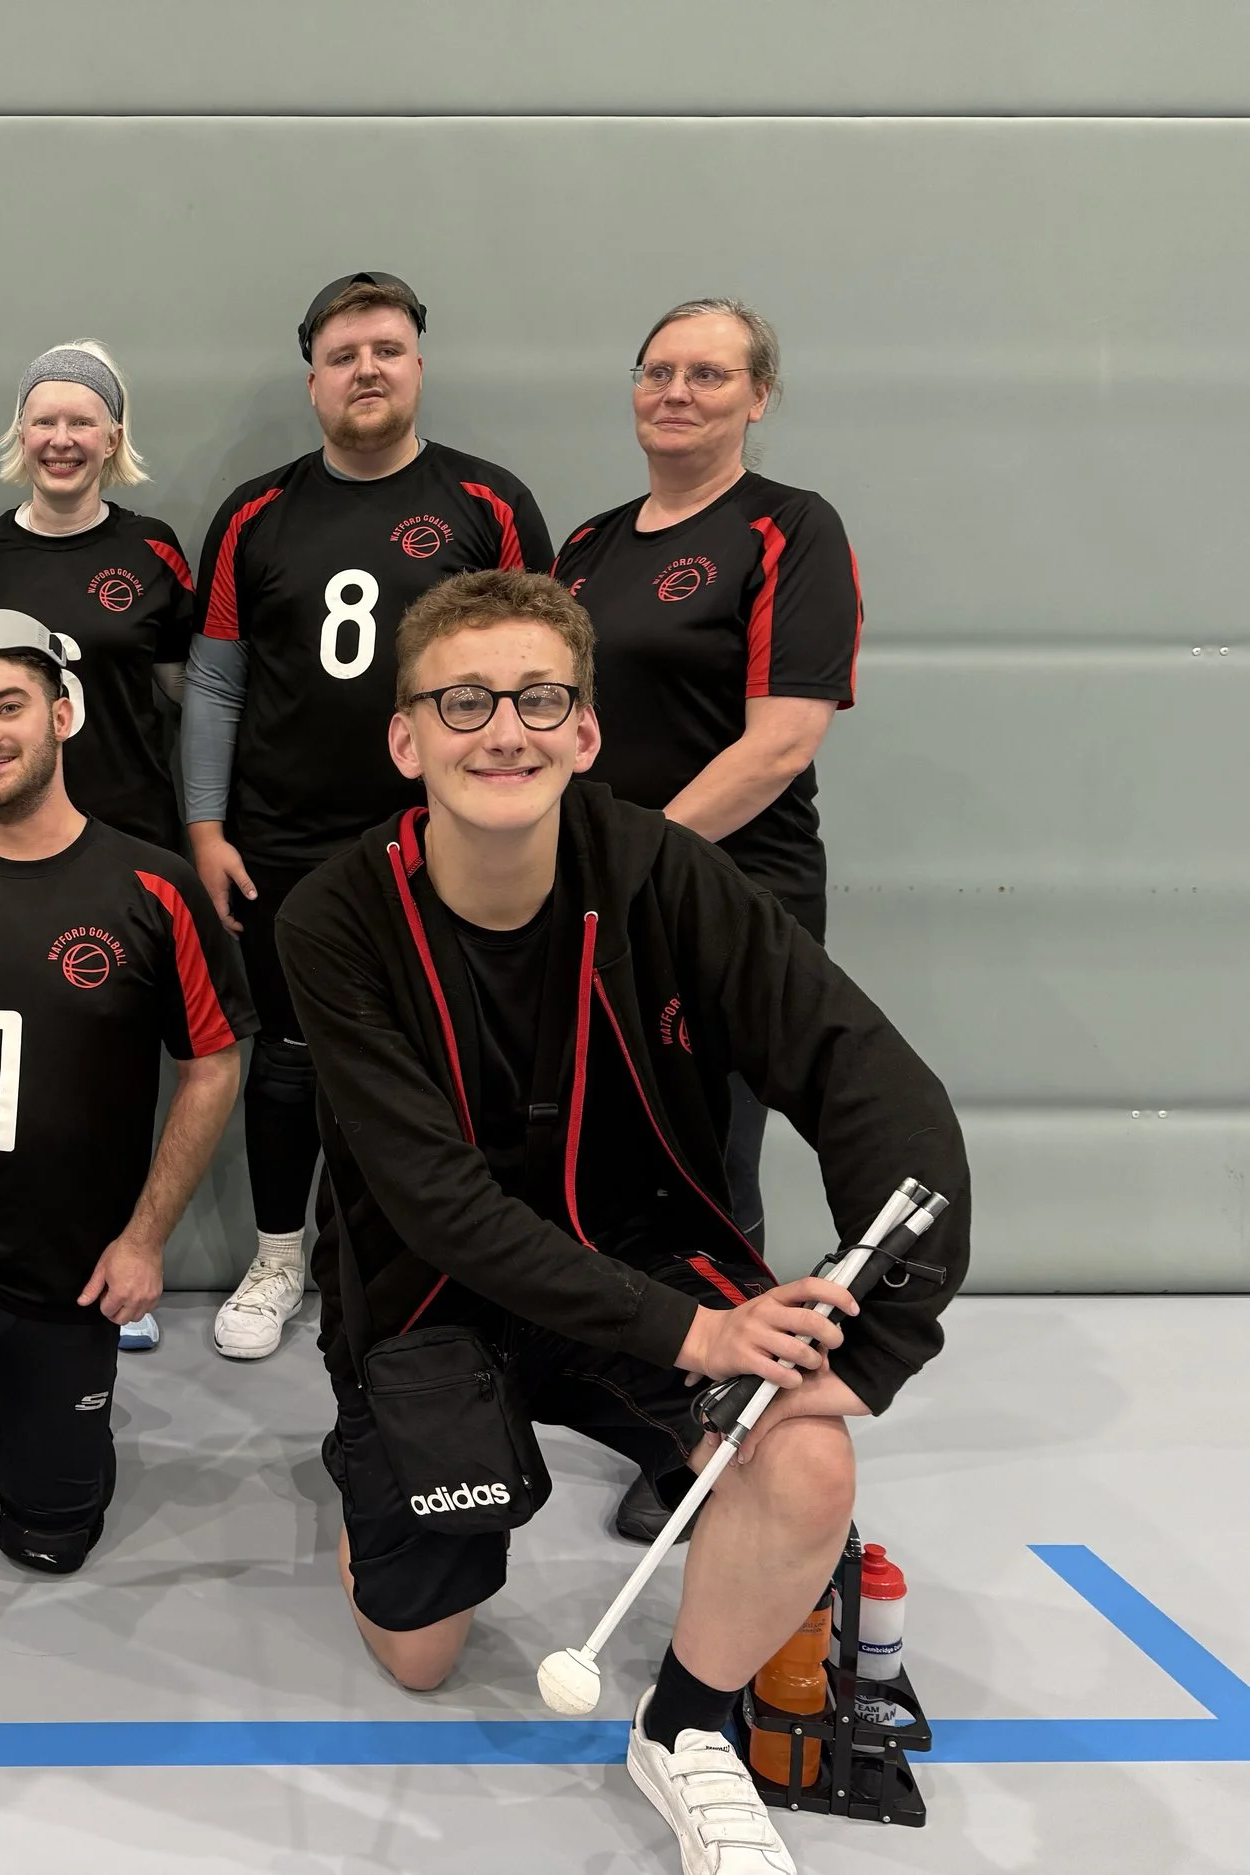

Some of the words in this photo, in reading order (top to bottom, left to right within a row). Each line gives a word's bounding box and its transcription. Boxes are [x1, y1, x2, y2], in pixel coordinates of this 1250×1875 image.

[390, 516, 421, 541] WATFORD
[423, 515, 454, 543] GOALBALL
[87, 569, 115, 593] WATFORD
[118, 568, 144, 597] GOALBALL
[652, 558, 693, 584] WATFORD
[694, 556, 718, 586] GOALBALL
[320, 569, 379, 680] 8
[48, 927, 86, 960] WATFORD
[89, 927, 127, 967] GOALBALL
[660, 993, 681, 1044] WATFOR
[411, 1483, 510, 1515] adidas
[862, 1644, 894, 1654] Cambridge
[857, 1703, 880, 1713] EAM
